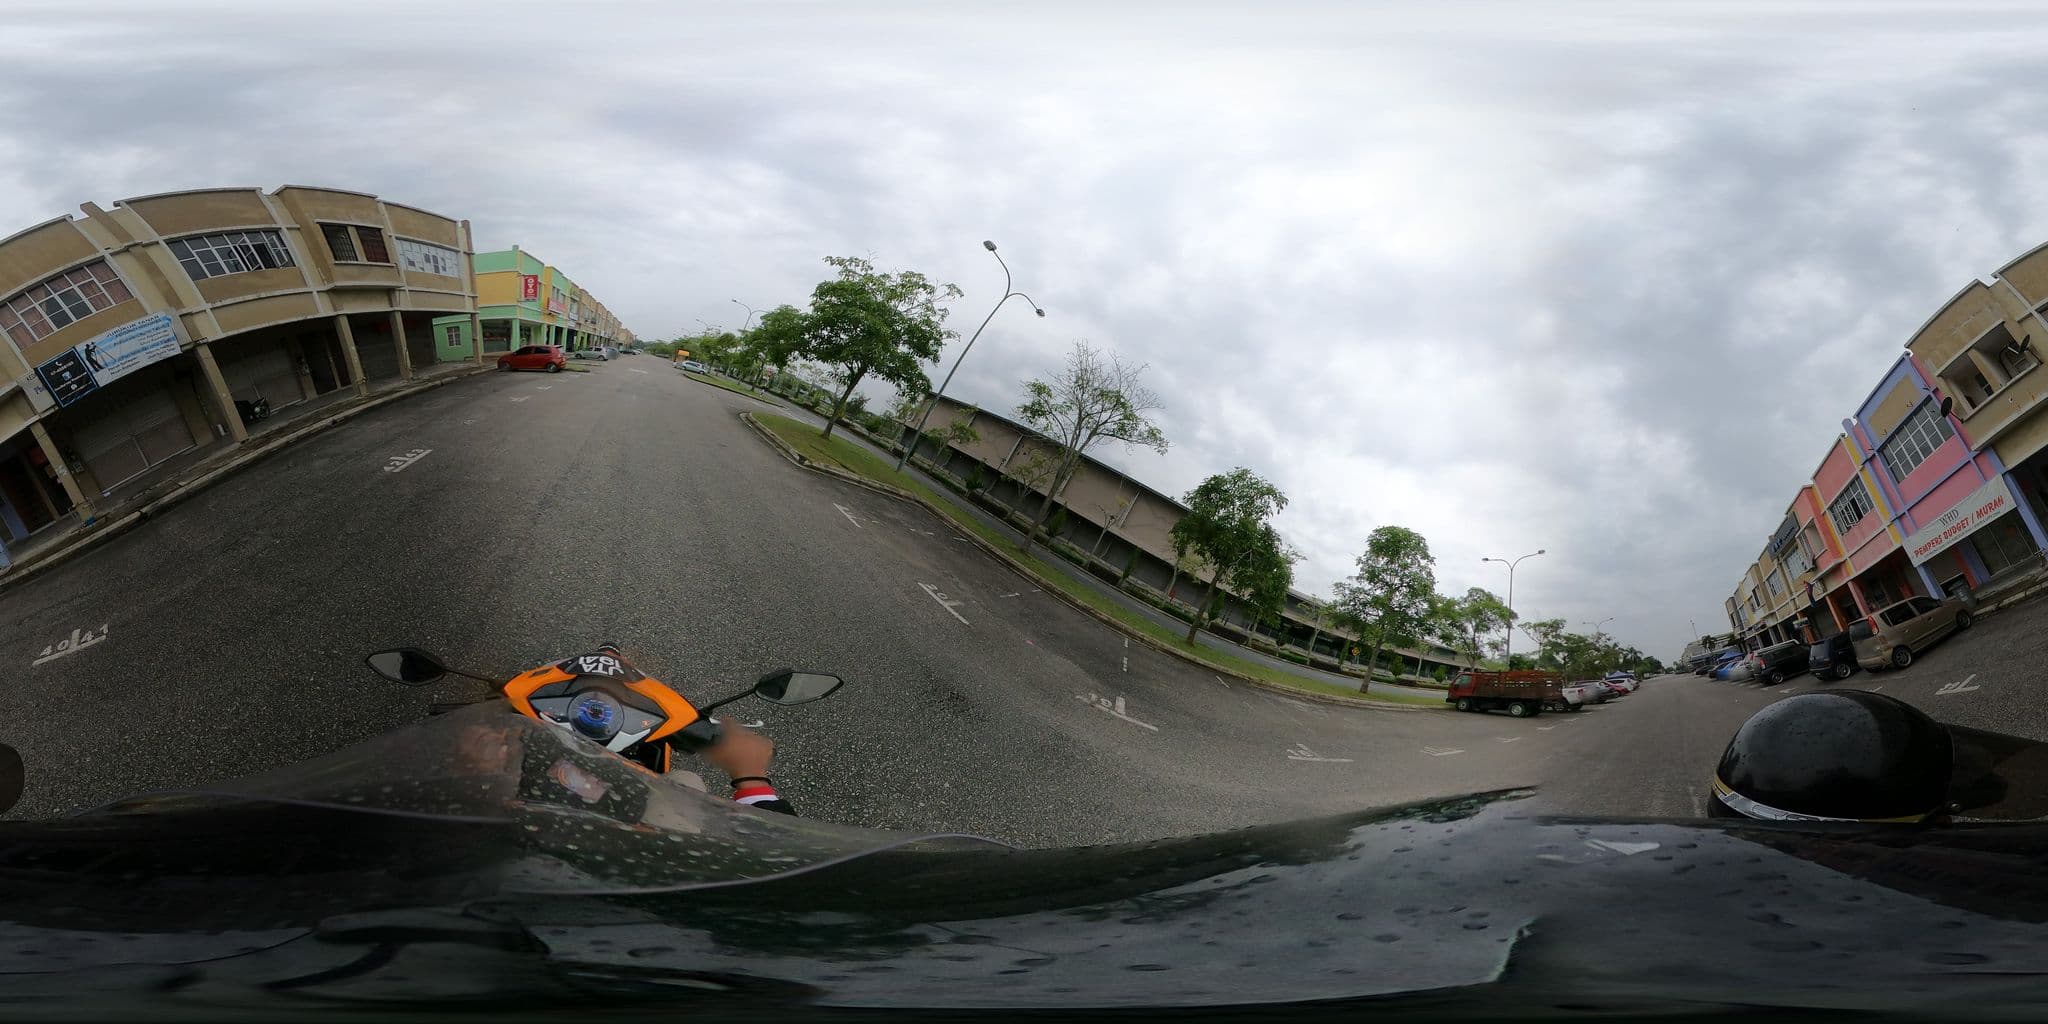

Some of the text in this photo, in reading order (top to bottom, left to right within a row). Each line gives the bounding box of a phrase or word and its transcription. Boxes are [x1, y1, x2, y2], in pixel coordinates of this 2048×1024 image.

[1939, 508, 1959, 526] WHD
[1913, 534, 1943, 558] PEMPERS
[1943, 517, 1970, 540] BUDGET
[579, 656, 621, 669] 1941
[582, 662, 624, 676] JTA
